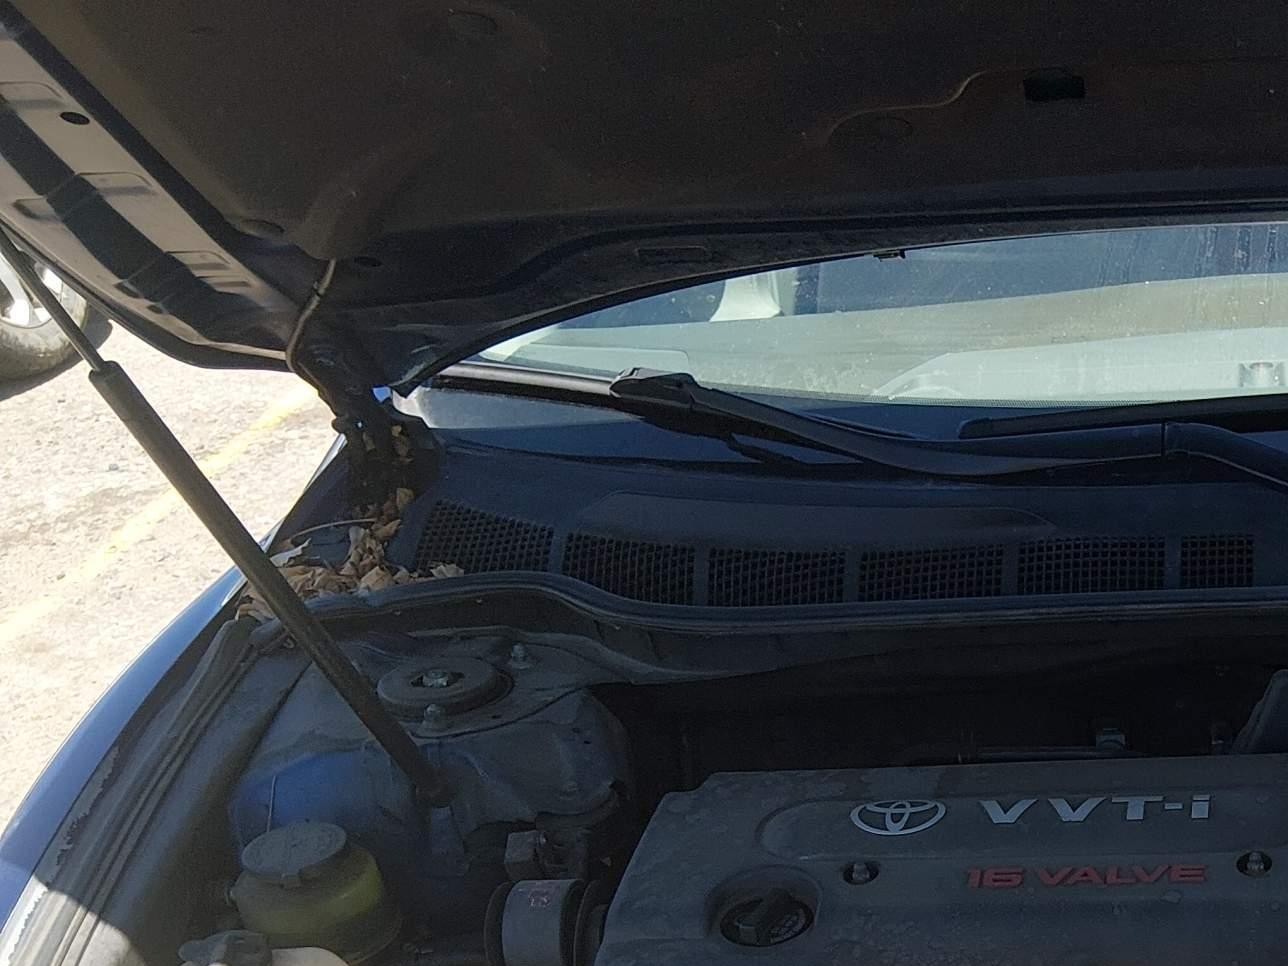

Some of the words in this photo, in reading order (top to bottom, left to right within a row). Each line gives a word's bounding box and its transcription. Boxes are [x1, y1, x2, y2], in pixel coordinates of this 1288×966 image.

[979, 794, 1214, 825] VVT-i
[967, 865, 1025, 888] 16
[1037, 863, 1209, 887] VALVE
